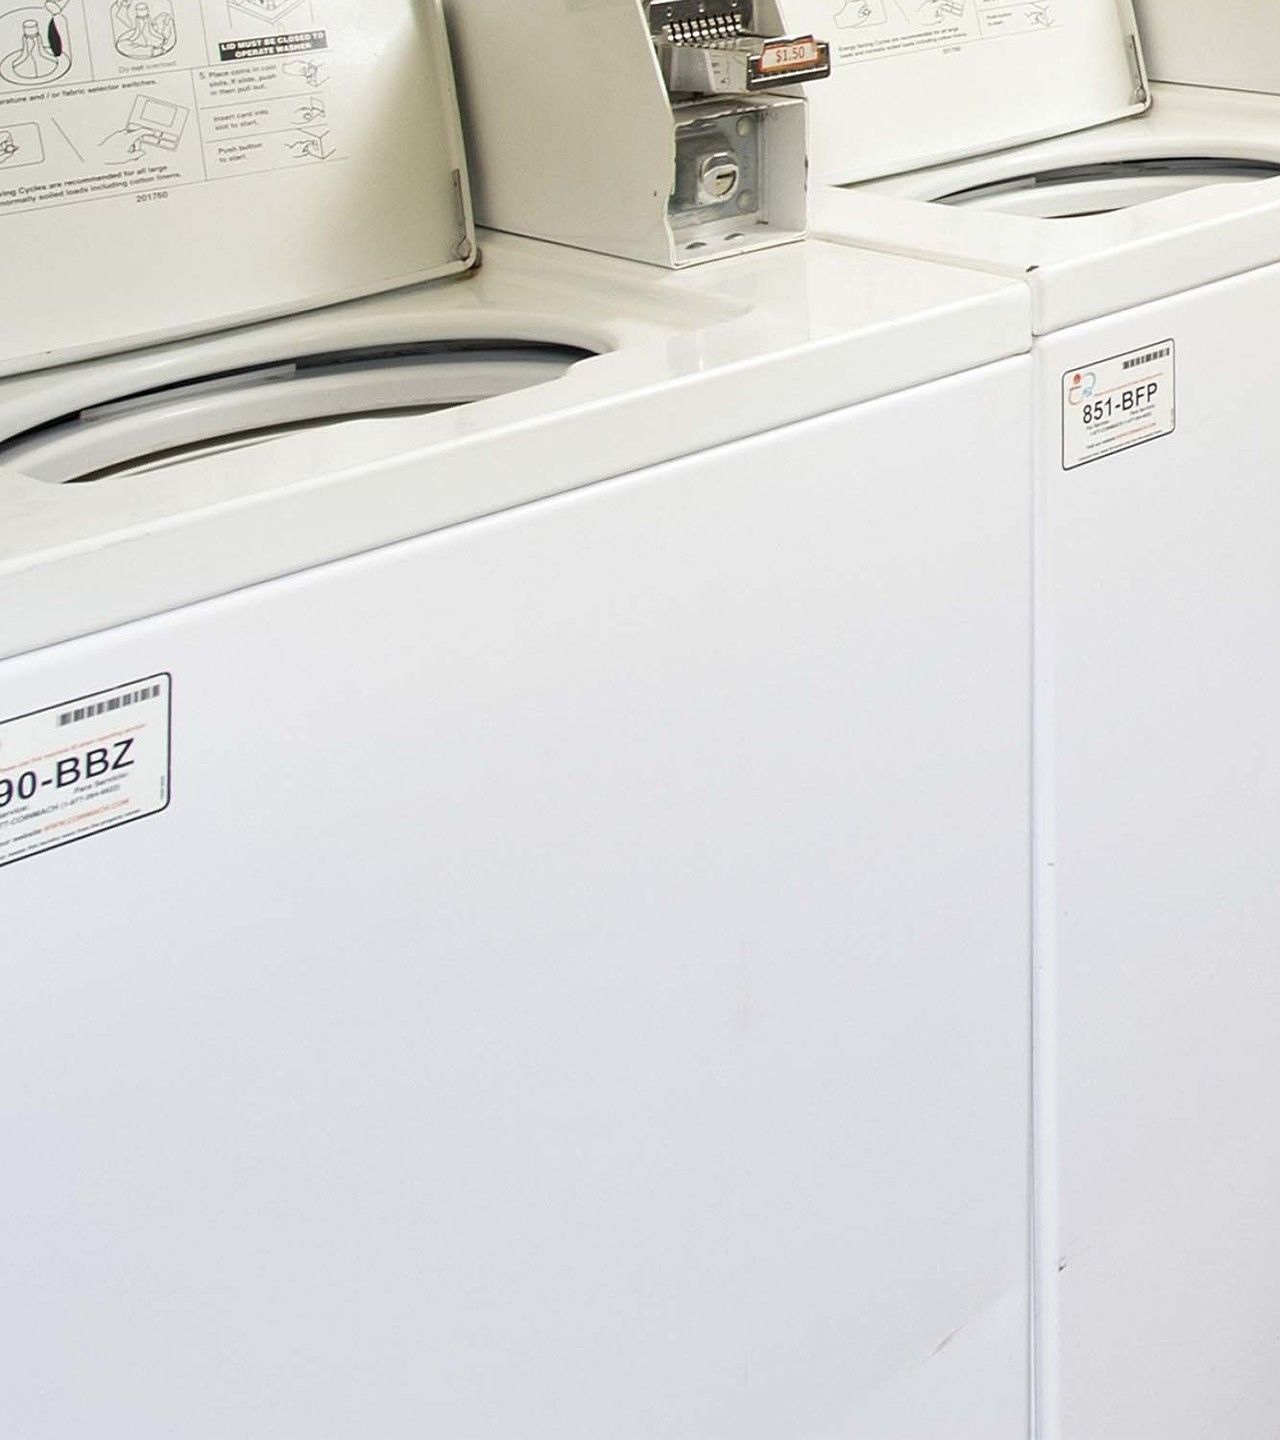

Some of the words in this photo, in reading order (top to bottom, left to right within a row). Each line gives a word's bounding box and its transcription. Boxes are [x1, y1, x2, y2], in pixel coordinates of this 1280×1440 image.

[220, 43, 237, 51] LID
[238, 40, 263, 50] MUST
[277, 34, 312, 44] CLOSED
[313, 31, 325, 40] TO
[235, 47, 275, 58] OPERATE
[276, 42, 313, 53] WASHER
[775, 46, 805, 64] $1.50
[18, 183, 48, 196] Cycles
[64, 170, 122, 187] recommended
[1083, 382, 1158, 424] 851-BFP
